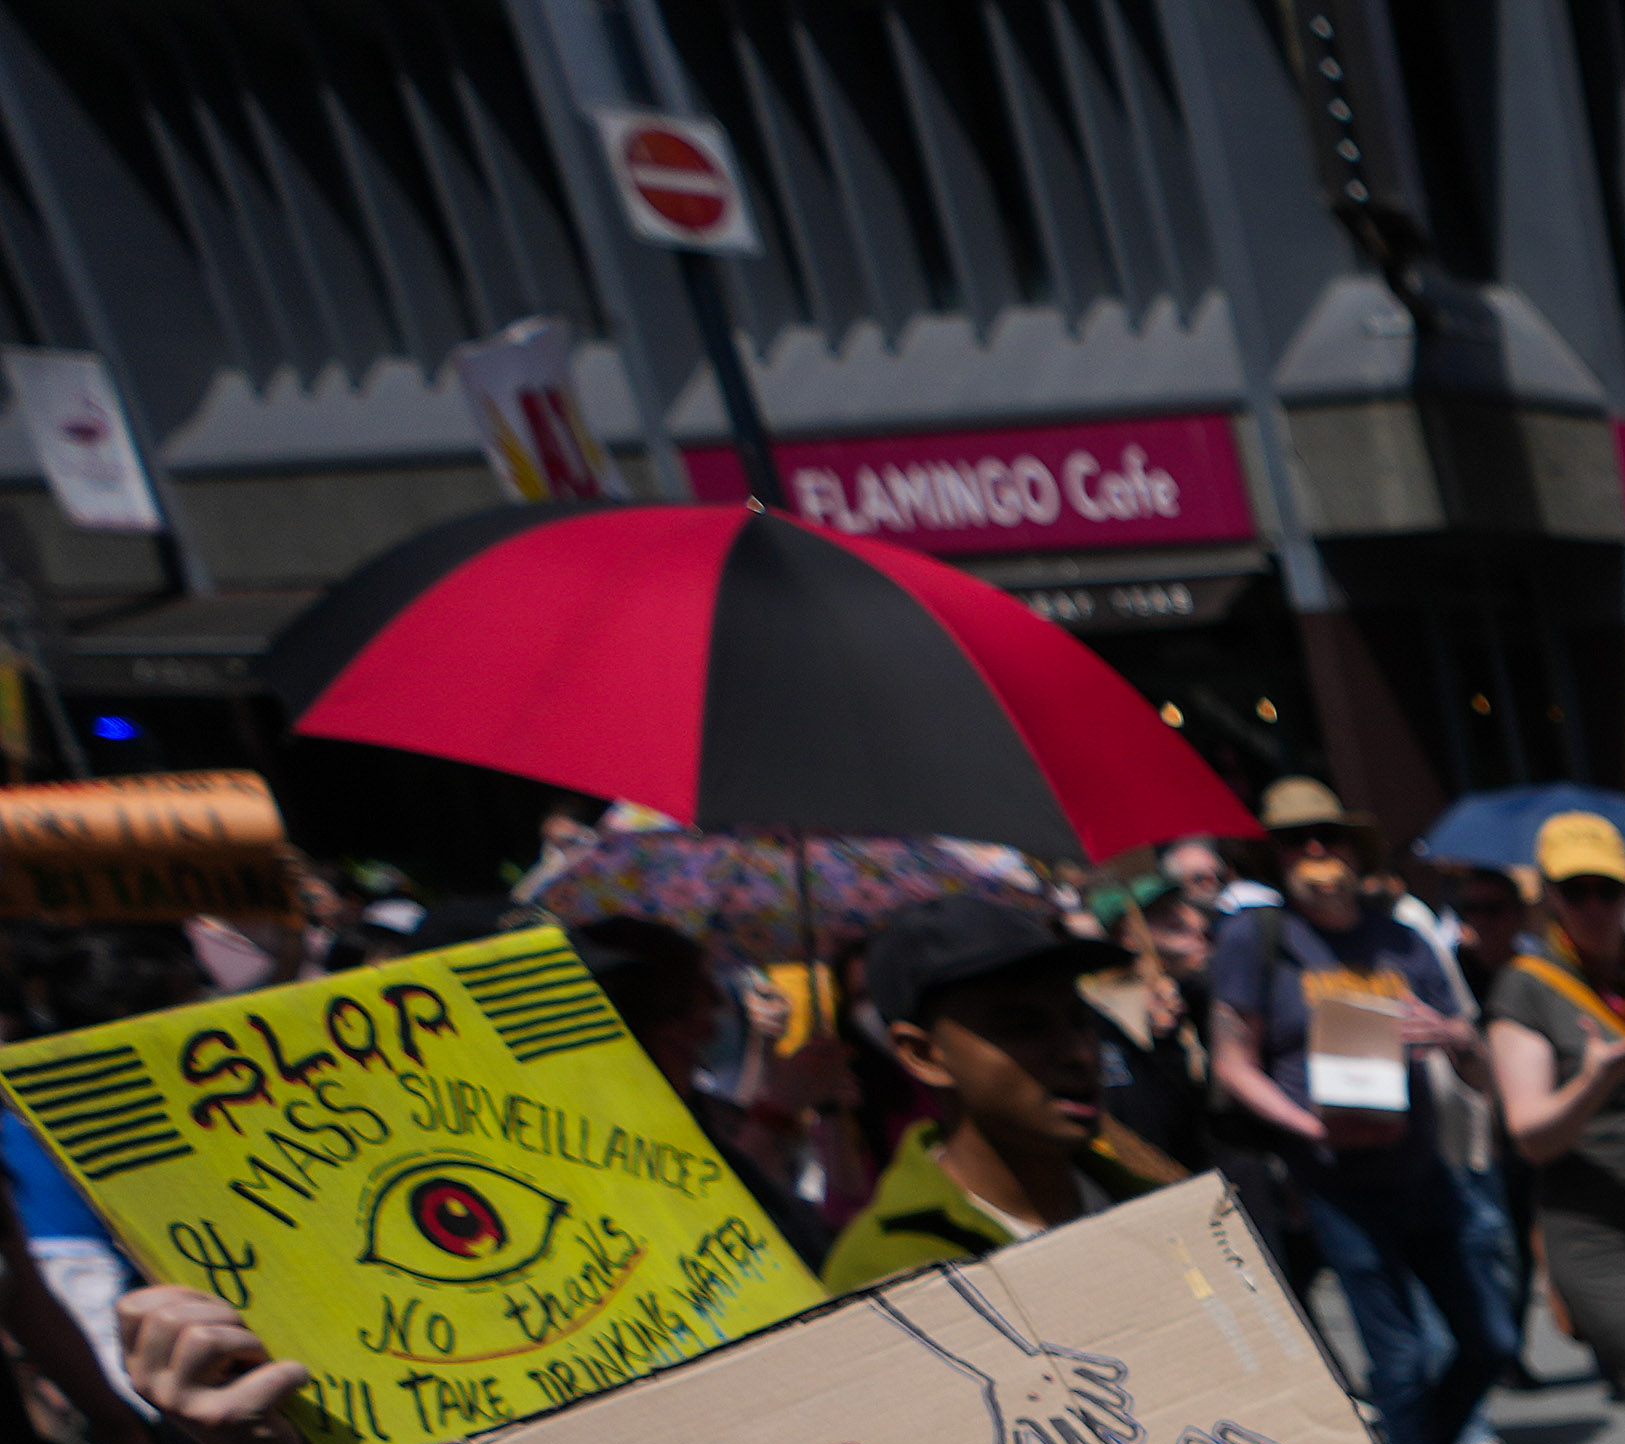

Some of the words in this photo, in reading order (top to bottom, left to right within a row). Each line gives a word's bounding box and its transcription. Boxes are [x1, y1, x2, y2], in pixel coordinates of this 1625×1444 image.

[791, 453, 1062, 535] FLAMINGO
[1063, 442, 1182, 524] Cafe
[181, 982, 456, 1136] SLOP
[169, 1220, 256, 1310] &
[229, 1082, 390, 1228] MASS
[358, 1295, 455, 1354] No
[504, 1215, 642, 1344] thanks
[400, 1370, 514, 1434] TAKE
